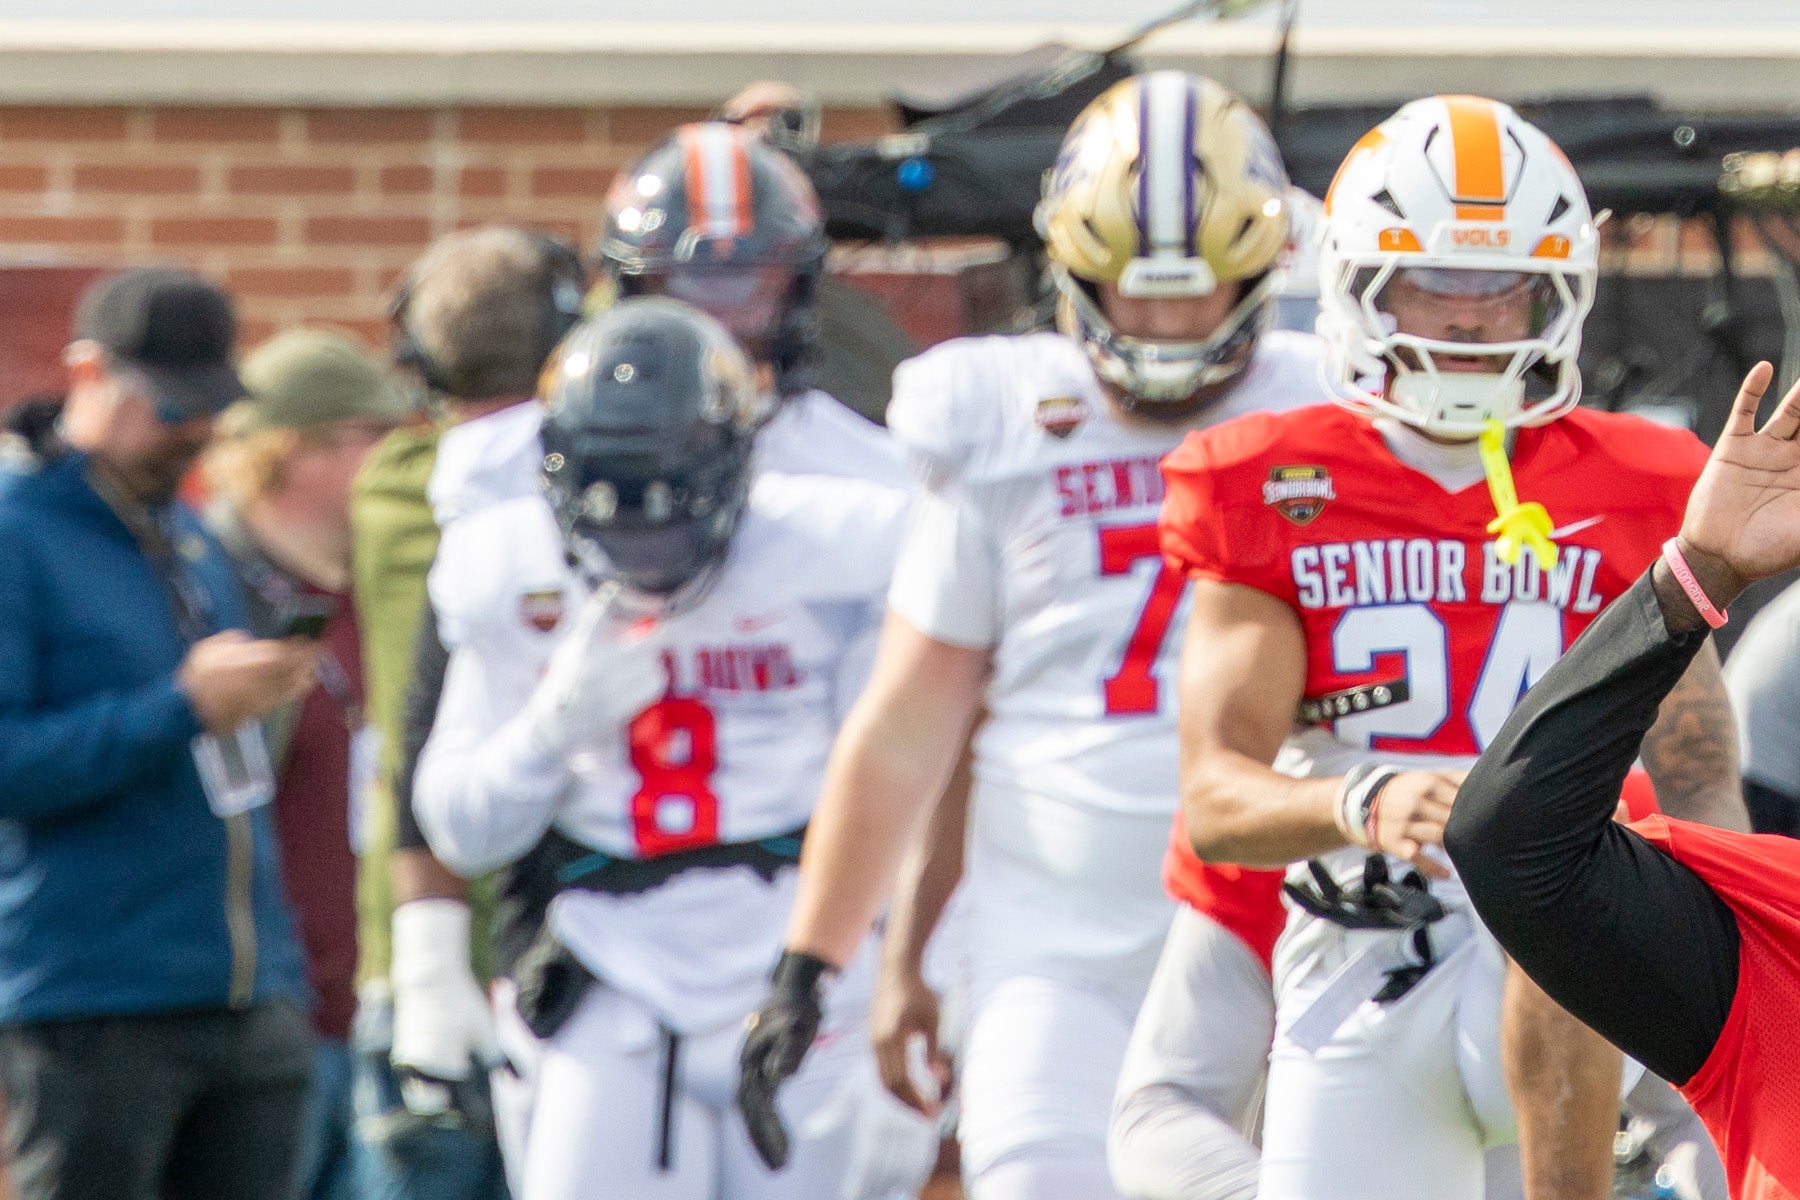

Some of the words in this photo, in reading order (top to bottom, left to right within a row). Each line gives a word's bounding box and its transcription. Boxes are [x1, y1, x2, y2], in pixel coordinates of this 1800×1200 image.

[1452, 228, 1510, 247] VOLS
[1099, 525, 1190, 712] 7
[1291, 538, 1466, 608] SENIOR
[1481, 540, 1604, 612] BOWL
[629, 697, 718, 856] 8
